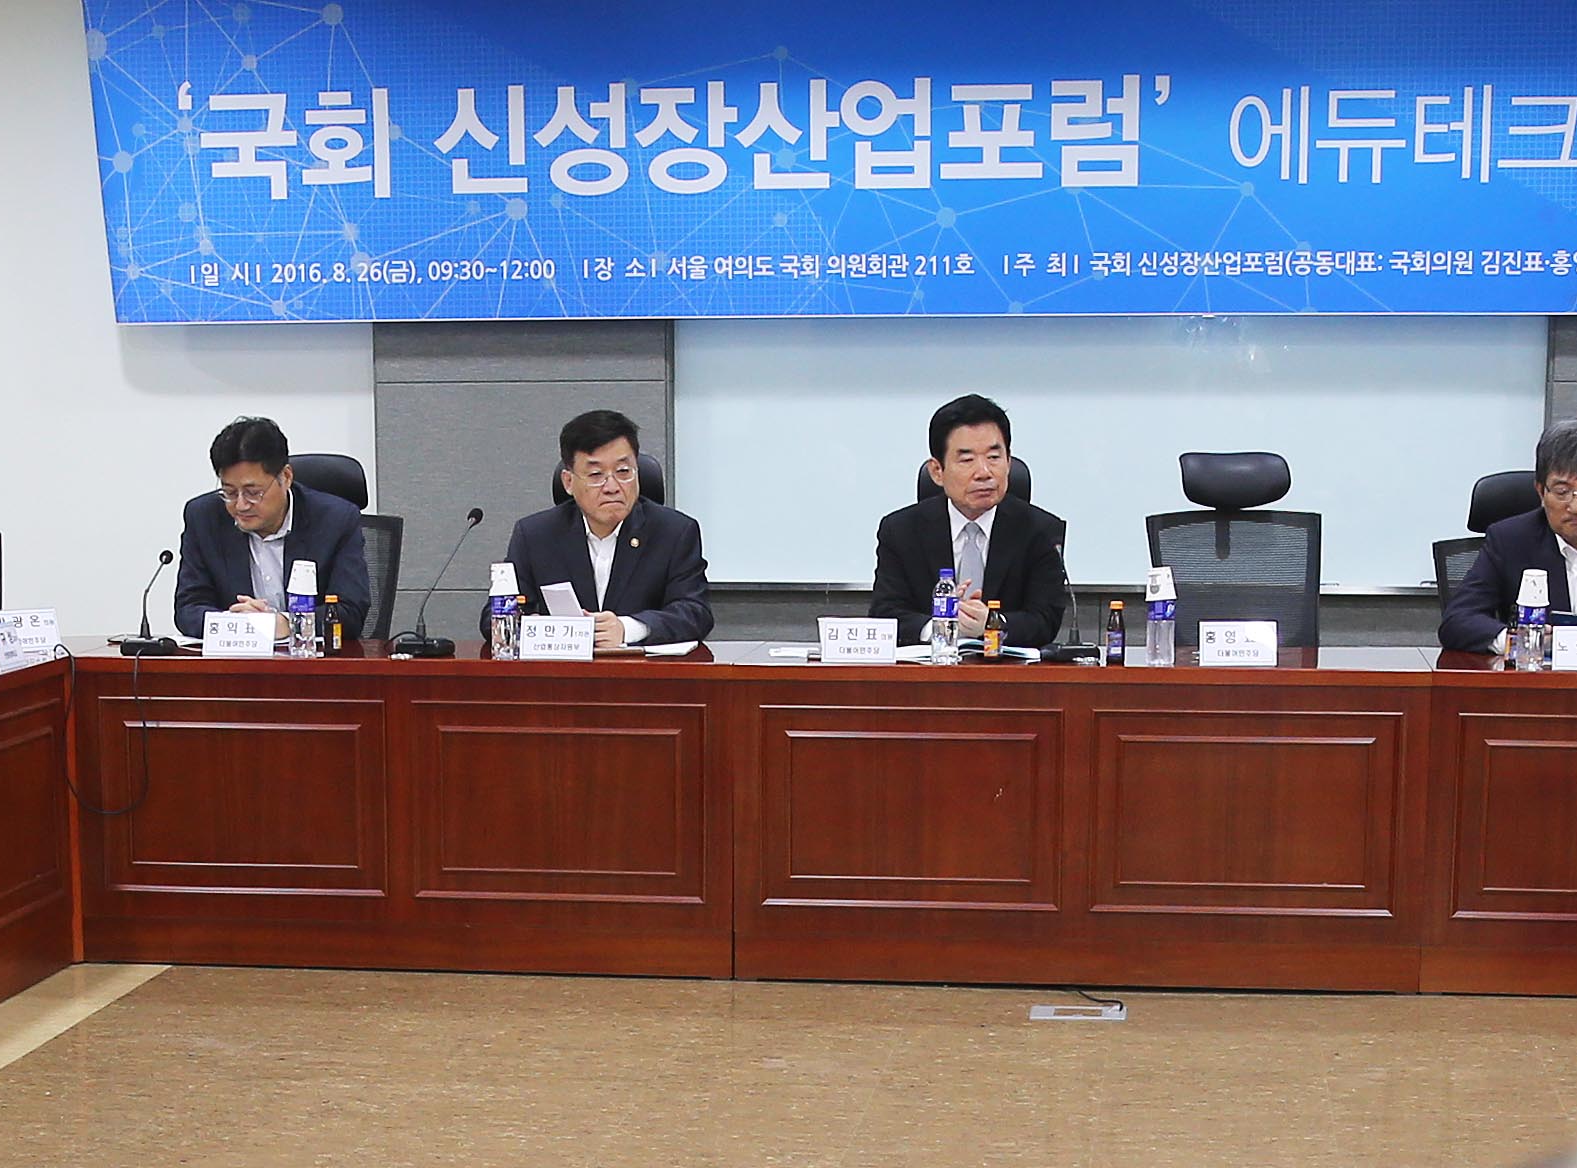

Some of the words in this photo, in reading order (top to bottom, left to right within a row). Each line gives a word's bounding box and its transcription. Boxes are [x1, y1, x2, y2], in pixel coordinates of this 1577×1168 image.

[428, 259, 555, 281] 09:30~12:00
[668, 255, 707, 281] 서울
[714, 255, 775, 280] 여의도
[779, 254, 820, 280] 국회
[826, 253, 909, 280] 의원회관
[914, 253, 975, 277] 211호
[1089, 252, 1131, 278] 국회
[1388, 249, 1474, 277] 국회의원
